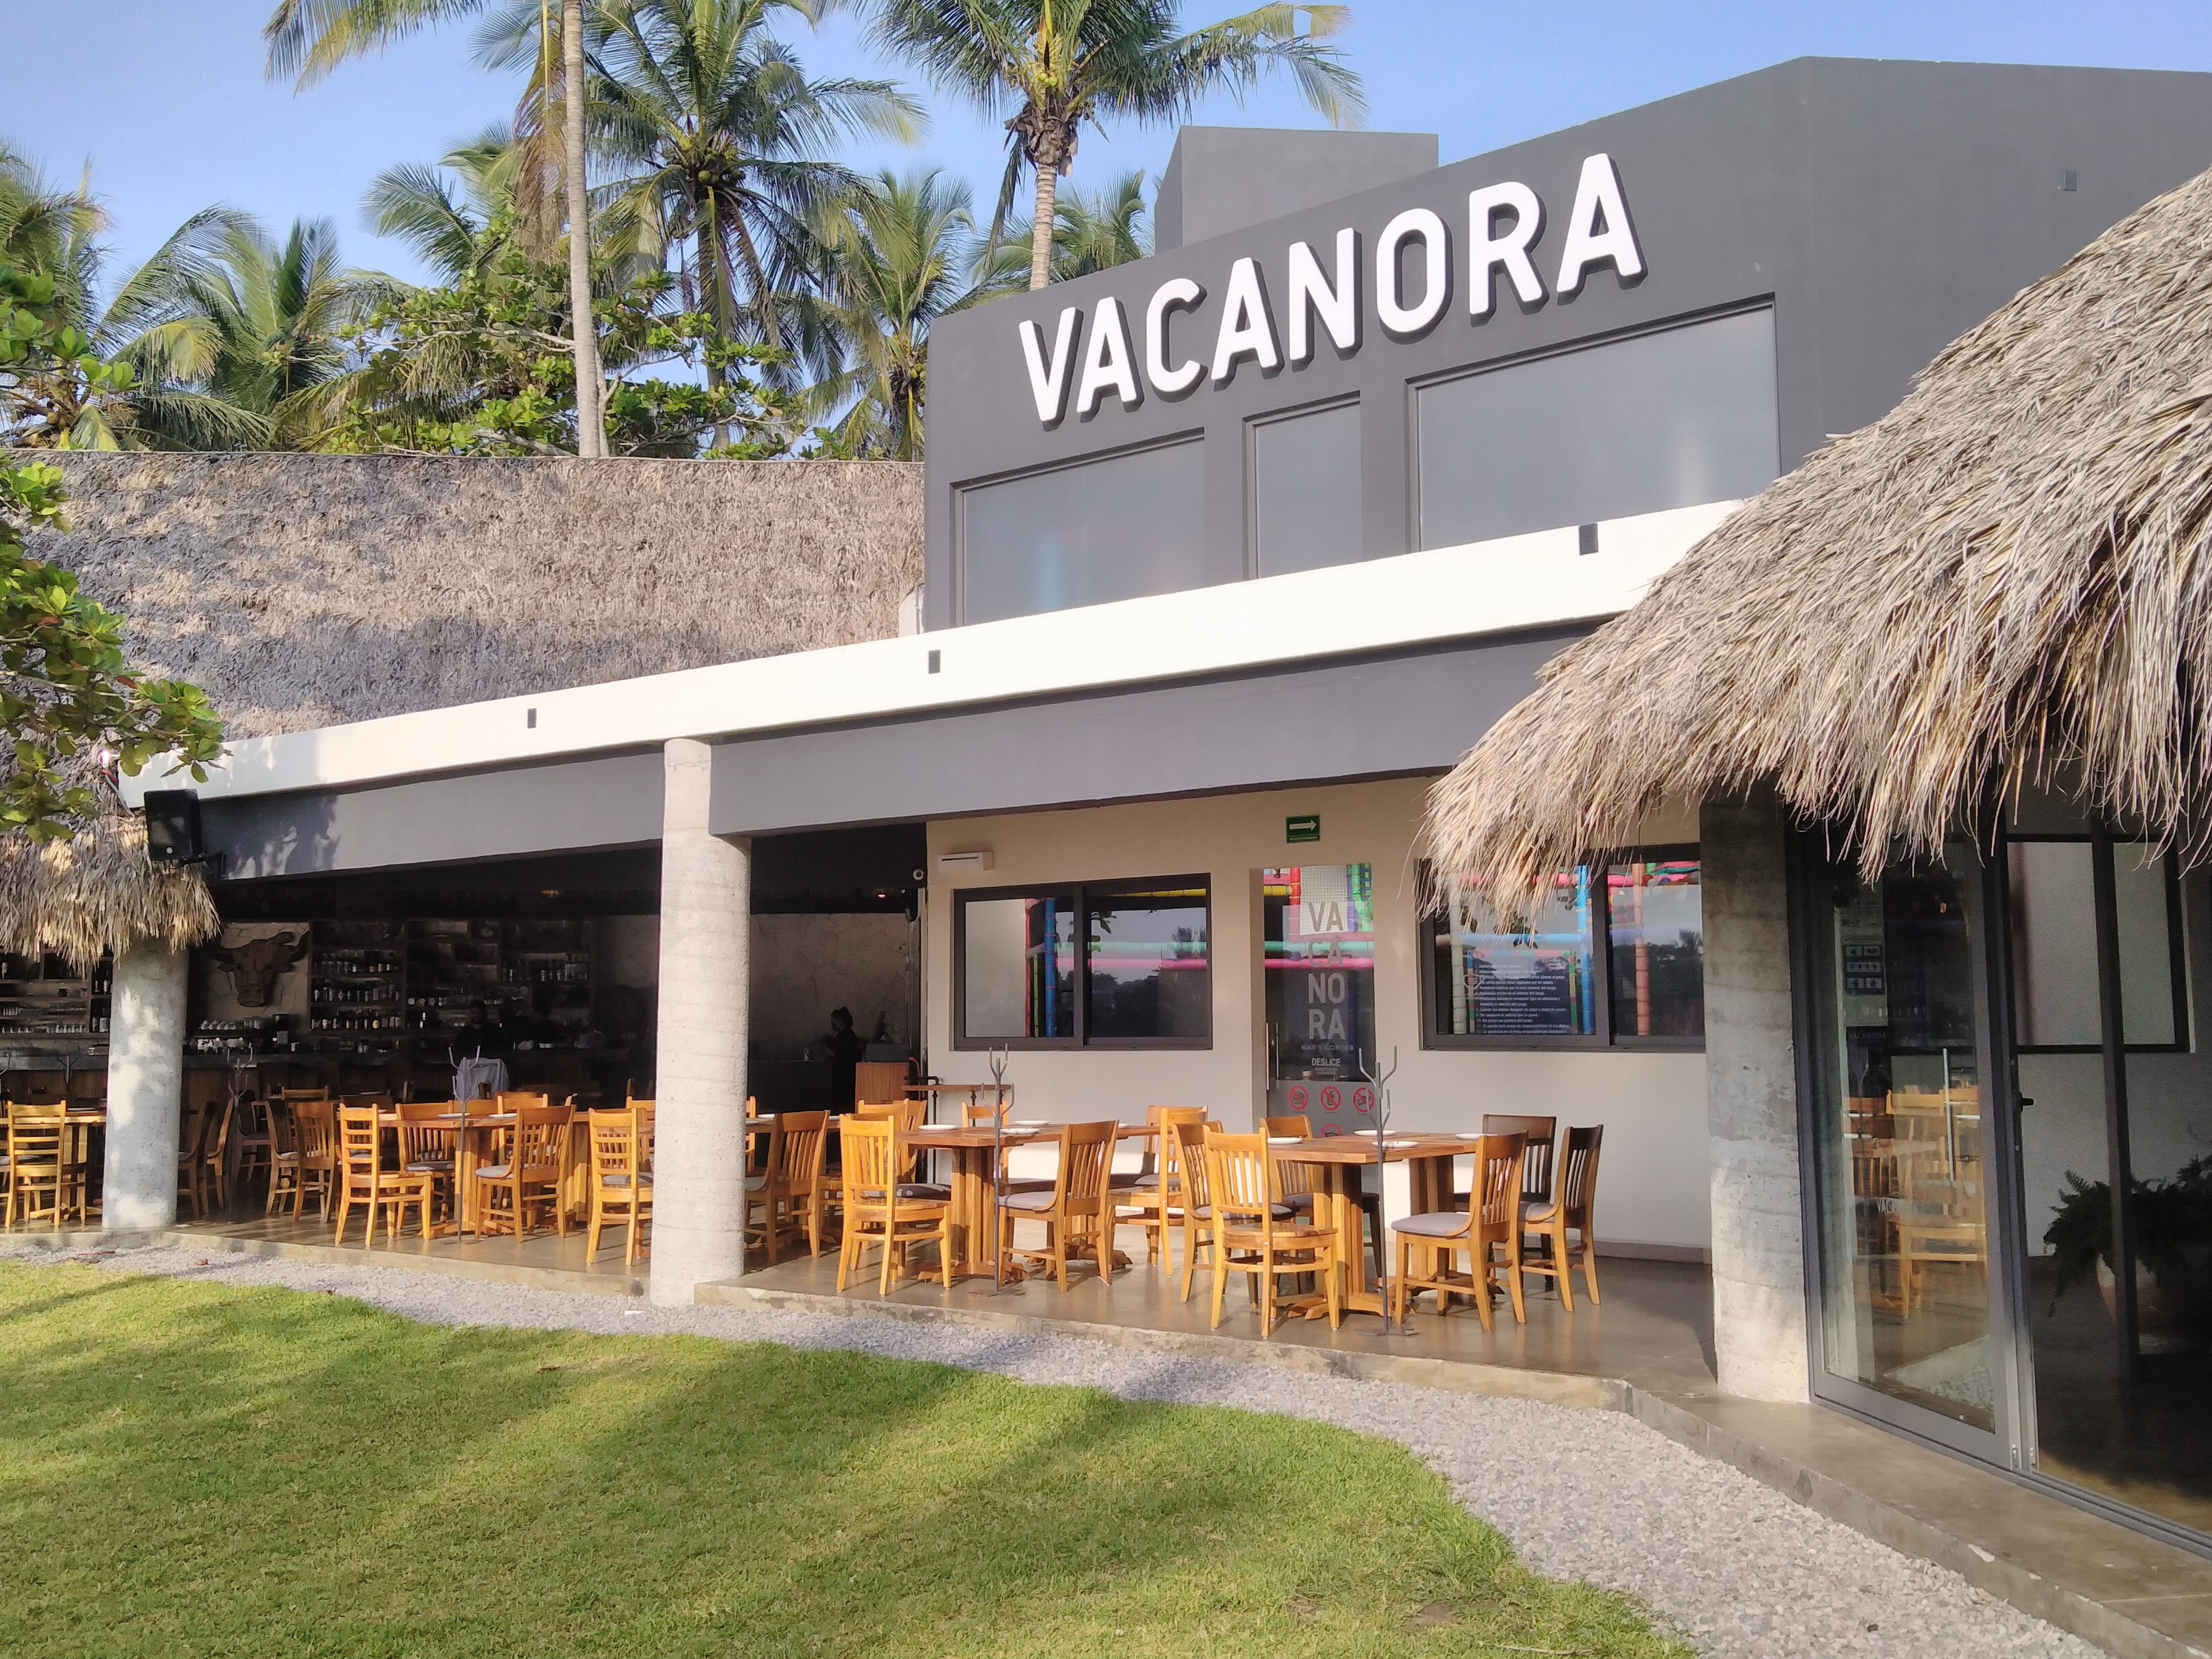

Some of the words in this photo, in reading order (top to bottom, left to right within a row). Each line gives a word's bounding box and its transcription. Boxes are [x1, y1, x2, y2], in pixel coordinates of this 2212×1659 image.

[1019, 152, 1644, 422] VACANORA
[1308, 901, 1343, 931] VA
[1308, 937, 1343, 967] CA
[1308, 972, 1345, 1003] NO
[1309, 1008, 1346, 1039] RA
[1311, 1058, 1341, 1066] DESLICE
